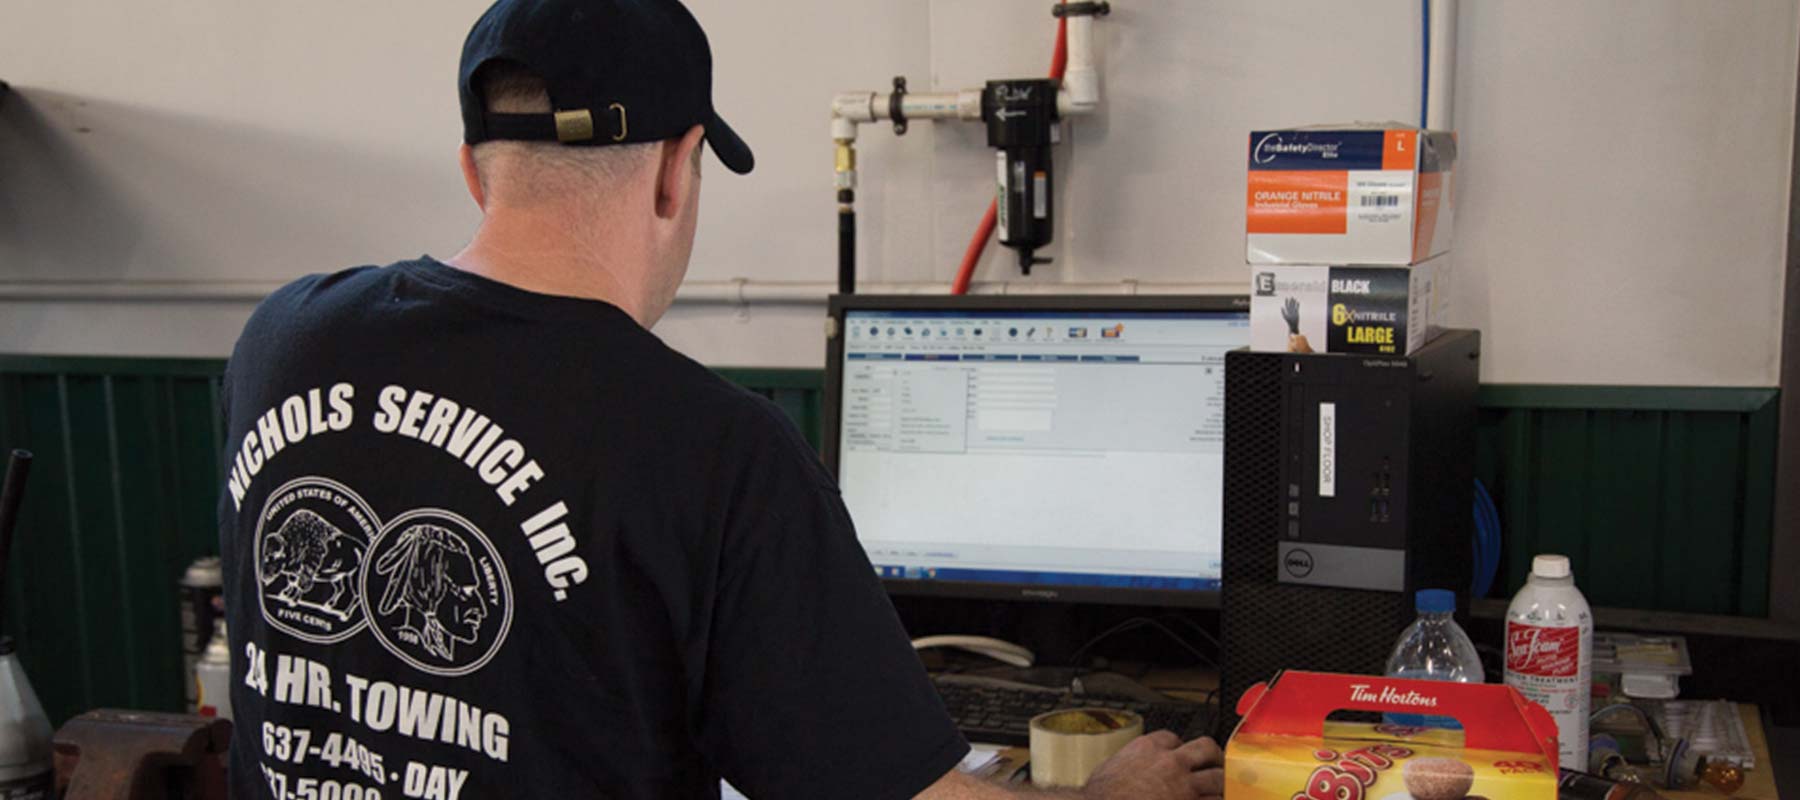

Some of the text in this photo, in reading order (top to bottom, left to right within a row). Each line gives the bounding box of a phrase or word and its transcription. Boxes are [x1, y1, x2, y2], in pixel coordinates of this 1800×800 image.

[1397, 140, 1405, 151] L
[1255, 191, 1341, 201] ORANGE NITRILE
[1331, 279, 1371, 294] BLACK
[1354, 311, 1396, 321] NITRILE
[1347, 326, 1394, 343] LARGE
[228, 382, 355, 512] NICHOLS
[373, 384, 545, 506] SERVICE
[1322, 416, 1332, 483] SHOP FLOOR
[266, 488, 377, 543] UNITED STATES OF AMERI
[479, 556, 498, 606] LIBERTY
[277, 608, 301, 623] FIVE
[245, 642, 510, 763] 24 HR. TOWING
[1350, 684, 1438, 707] Tim Hortons
[262, 721, 469, 800] 637-4495 DAY
